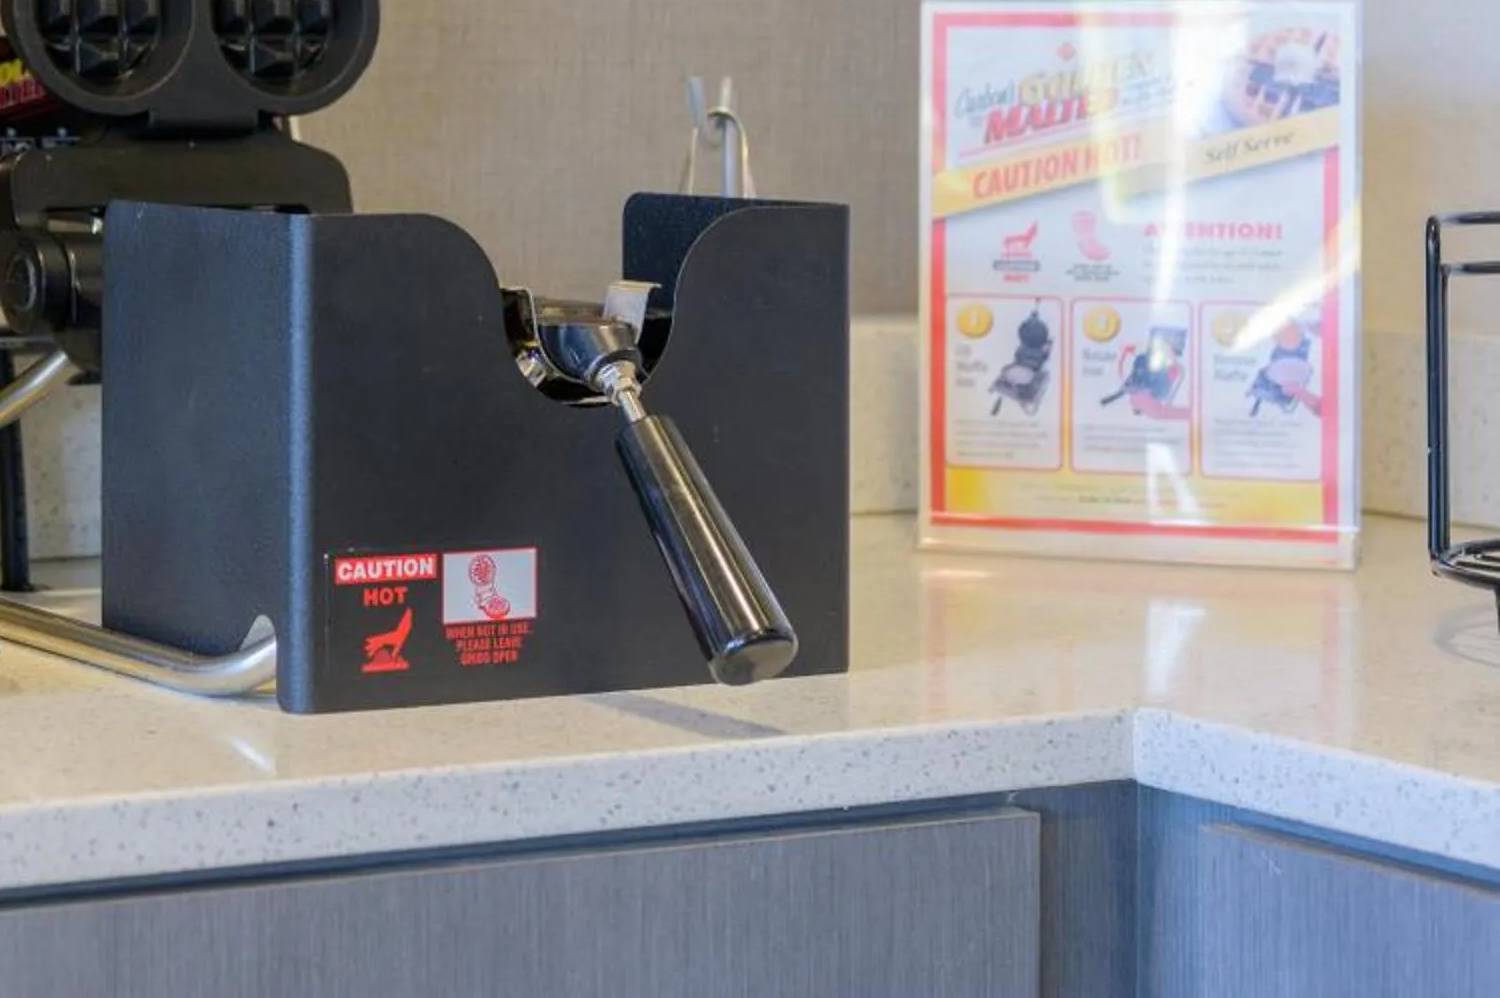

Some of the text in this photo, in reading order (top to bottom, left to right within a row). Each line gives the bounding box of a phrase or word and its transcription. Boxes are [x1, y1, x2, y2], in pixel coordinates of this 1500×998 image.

[1204, 129, 1296, 164] Self Serve
[971, 146, 1081, 199] CAUTION
[1143, 221, 1283, 241] AENTION!
[337, 557, 435, 582] CAUTION
[363, 586, 408, 606] HOT
[446, 625, 475, 640] WHEN
[476, 624, 496, 637] NOT
[455, 635, 522, 652] PLEASE LEAVE
[492, 649, 518, 664] OPEN
